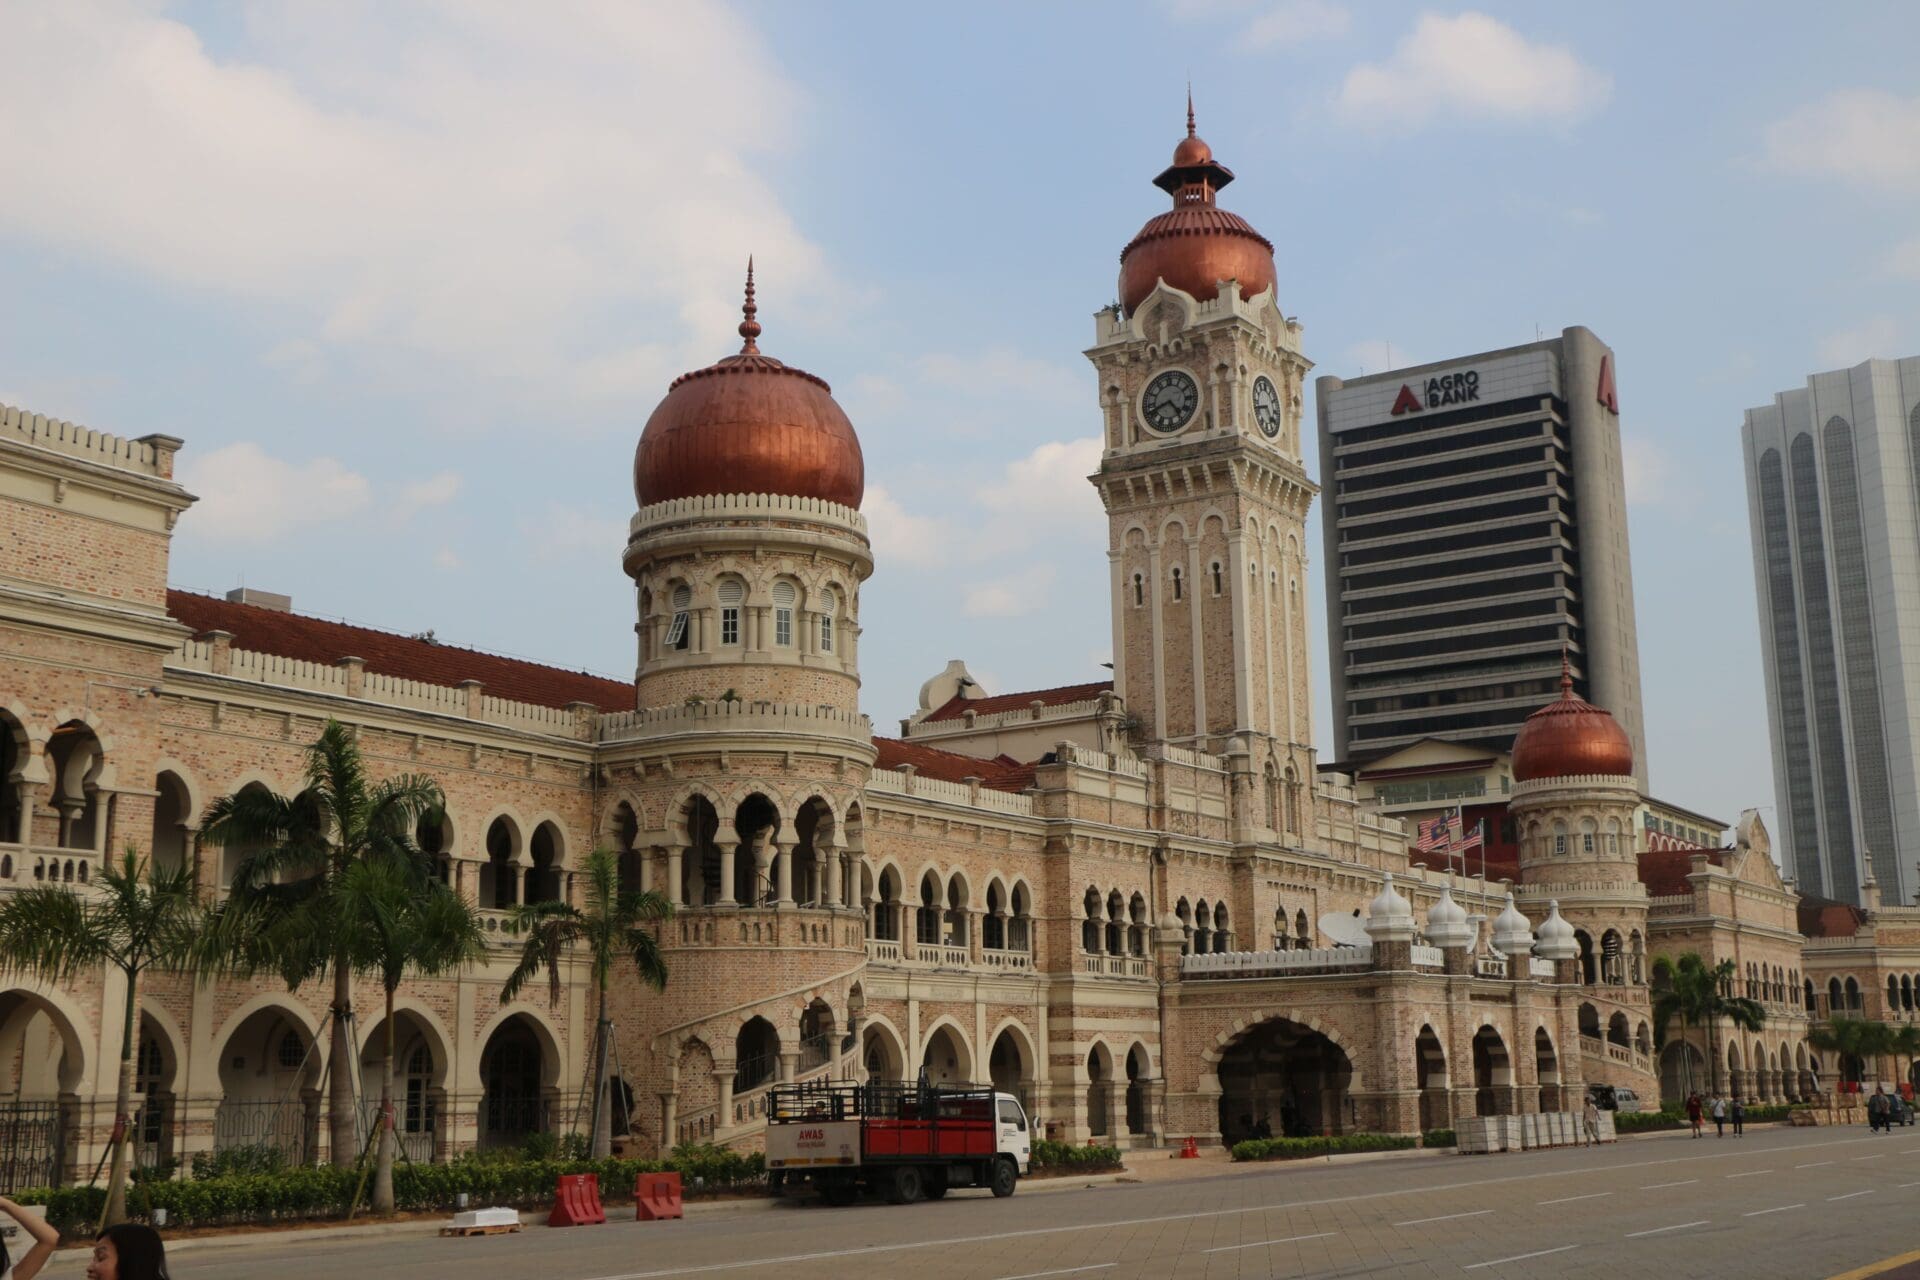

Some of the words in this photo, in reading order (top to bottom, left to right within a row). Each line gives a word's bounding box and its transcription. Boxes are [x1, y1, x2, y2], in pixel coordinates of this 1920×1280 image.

[1428, 370, 1479, 392] AGRO
[1429, 386, 1480, 408] BANK
[799, 1129, 824, 1140] AWAS
